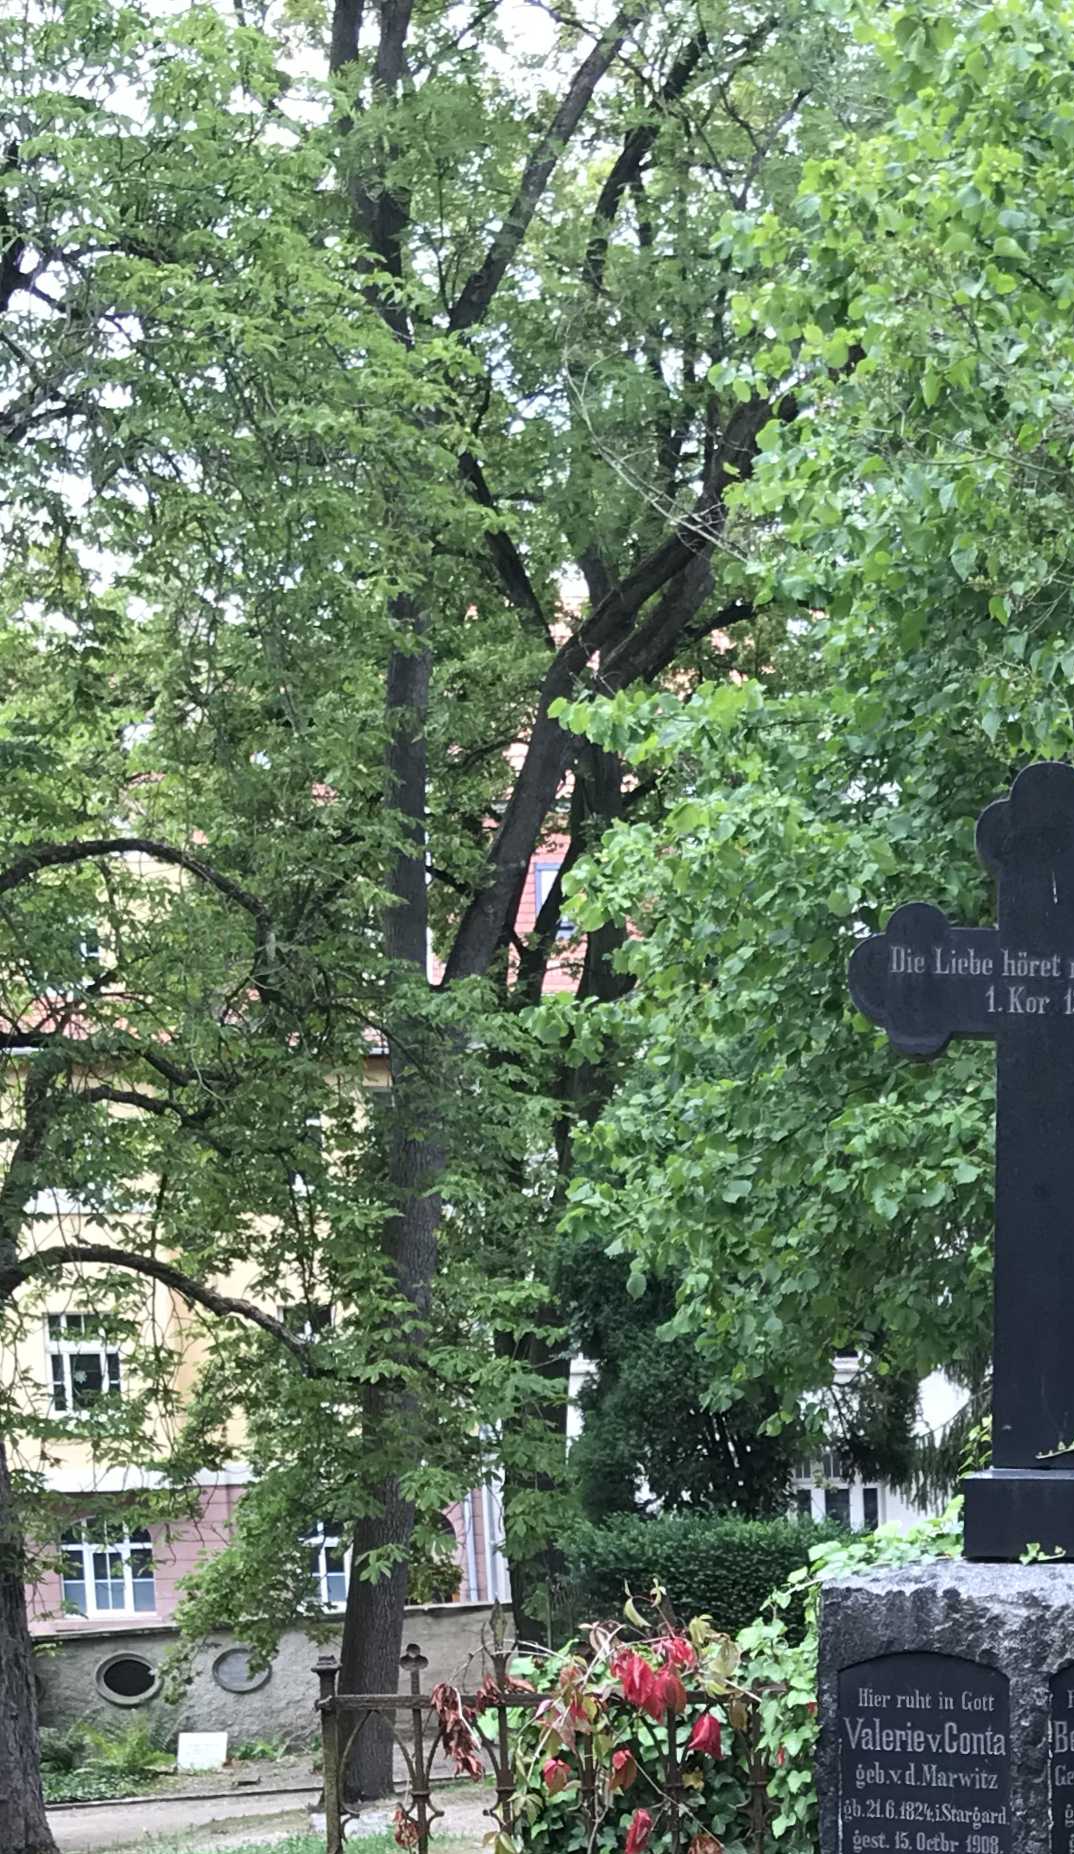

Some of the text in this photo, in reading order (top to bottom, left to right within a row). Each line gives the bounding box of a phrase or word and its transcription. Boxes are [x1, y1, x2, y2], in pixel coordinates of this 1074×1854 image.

[890, 946, 925, 974] Die
[935, 949, 993, 975] Liebe
[1001, 950, 1061, 977] höret
[1009, 988, 1050, 1014] Kor
[859, 1688, 995, 1711] Hier ruht in Gott
[843, 1717, 925, 1752] Valerie
[944, 1722, 1005, 1756] Conta
[852, 1829, 1003, 1854] gest. 15. Octbr 1908.
